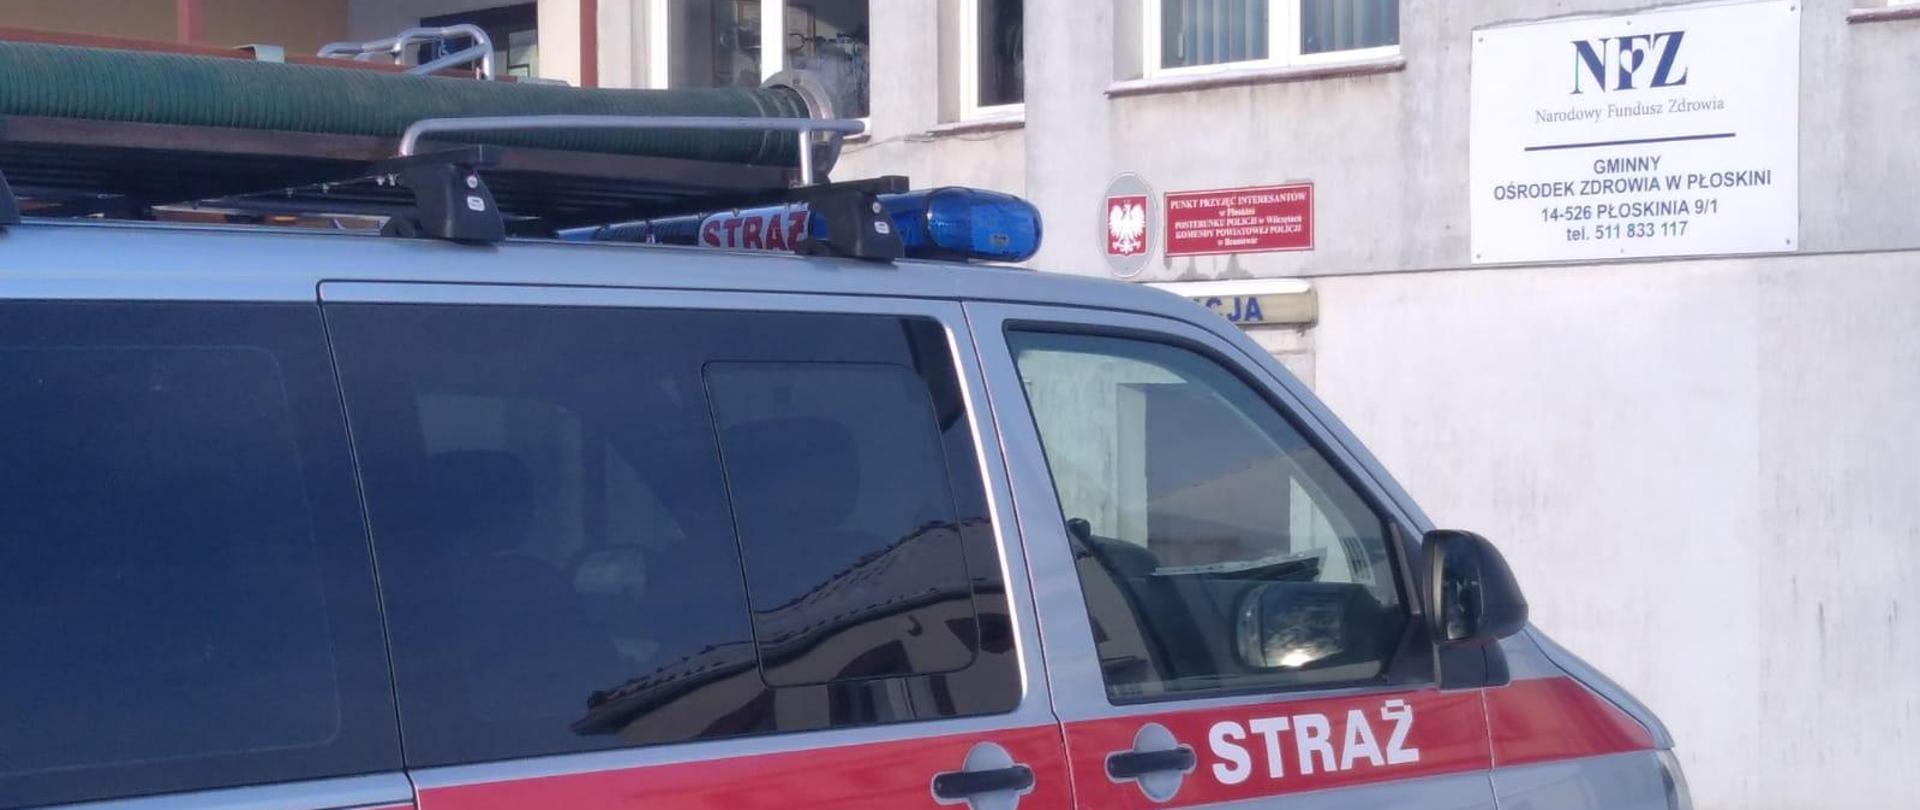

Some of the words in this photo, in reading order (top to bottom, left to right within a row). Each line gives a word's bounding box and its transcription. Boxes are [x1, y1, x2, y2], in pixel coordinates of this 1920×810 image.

[1569, 30, 1688, 94] NFZ
[1535, 106, 1603, 123] Narodowy
[1607, 100, 1663, 118] Fundusz
[1668, 97, 1725, 113] Zdrowia
[1593, 156, 1661, 175] GMINNY
[1493, 180, 1575, 201] OŚRODEK
[1580, 176, 1661, 196] ZDROWIA
[1665, 175, 1682, 191] W
[1687, 169, 1772, 190] PŁOSKINI
[1170, 199, 1197, 209] PUNKT
[1541, 205, 1592, 222] 14-526
[1597, 199, 1690, 219] PŁOSKINIA
[1694, 198, 1718, 215] 9/1
[1227, 216, 1257, 228] POLICJI
[1270, 224, 1302, 234] POLICJI
[1566, 226, 1590, 241] tel.
[1595, 224, 1621, 240] 511
[1627, 221, 1655, 238] 833
[1660, 220, 1688, 237] 117
[1208, 699, 1420, 785] STRAŻ
